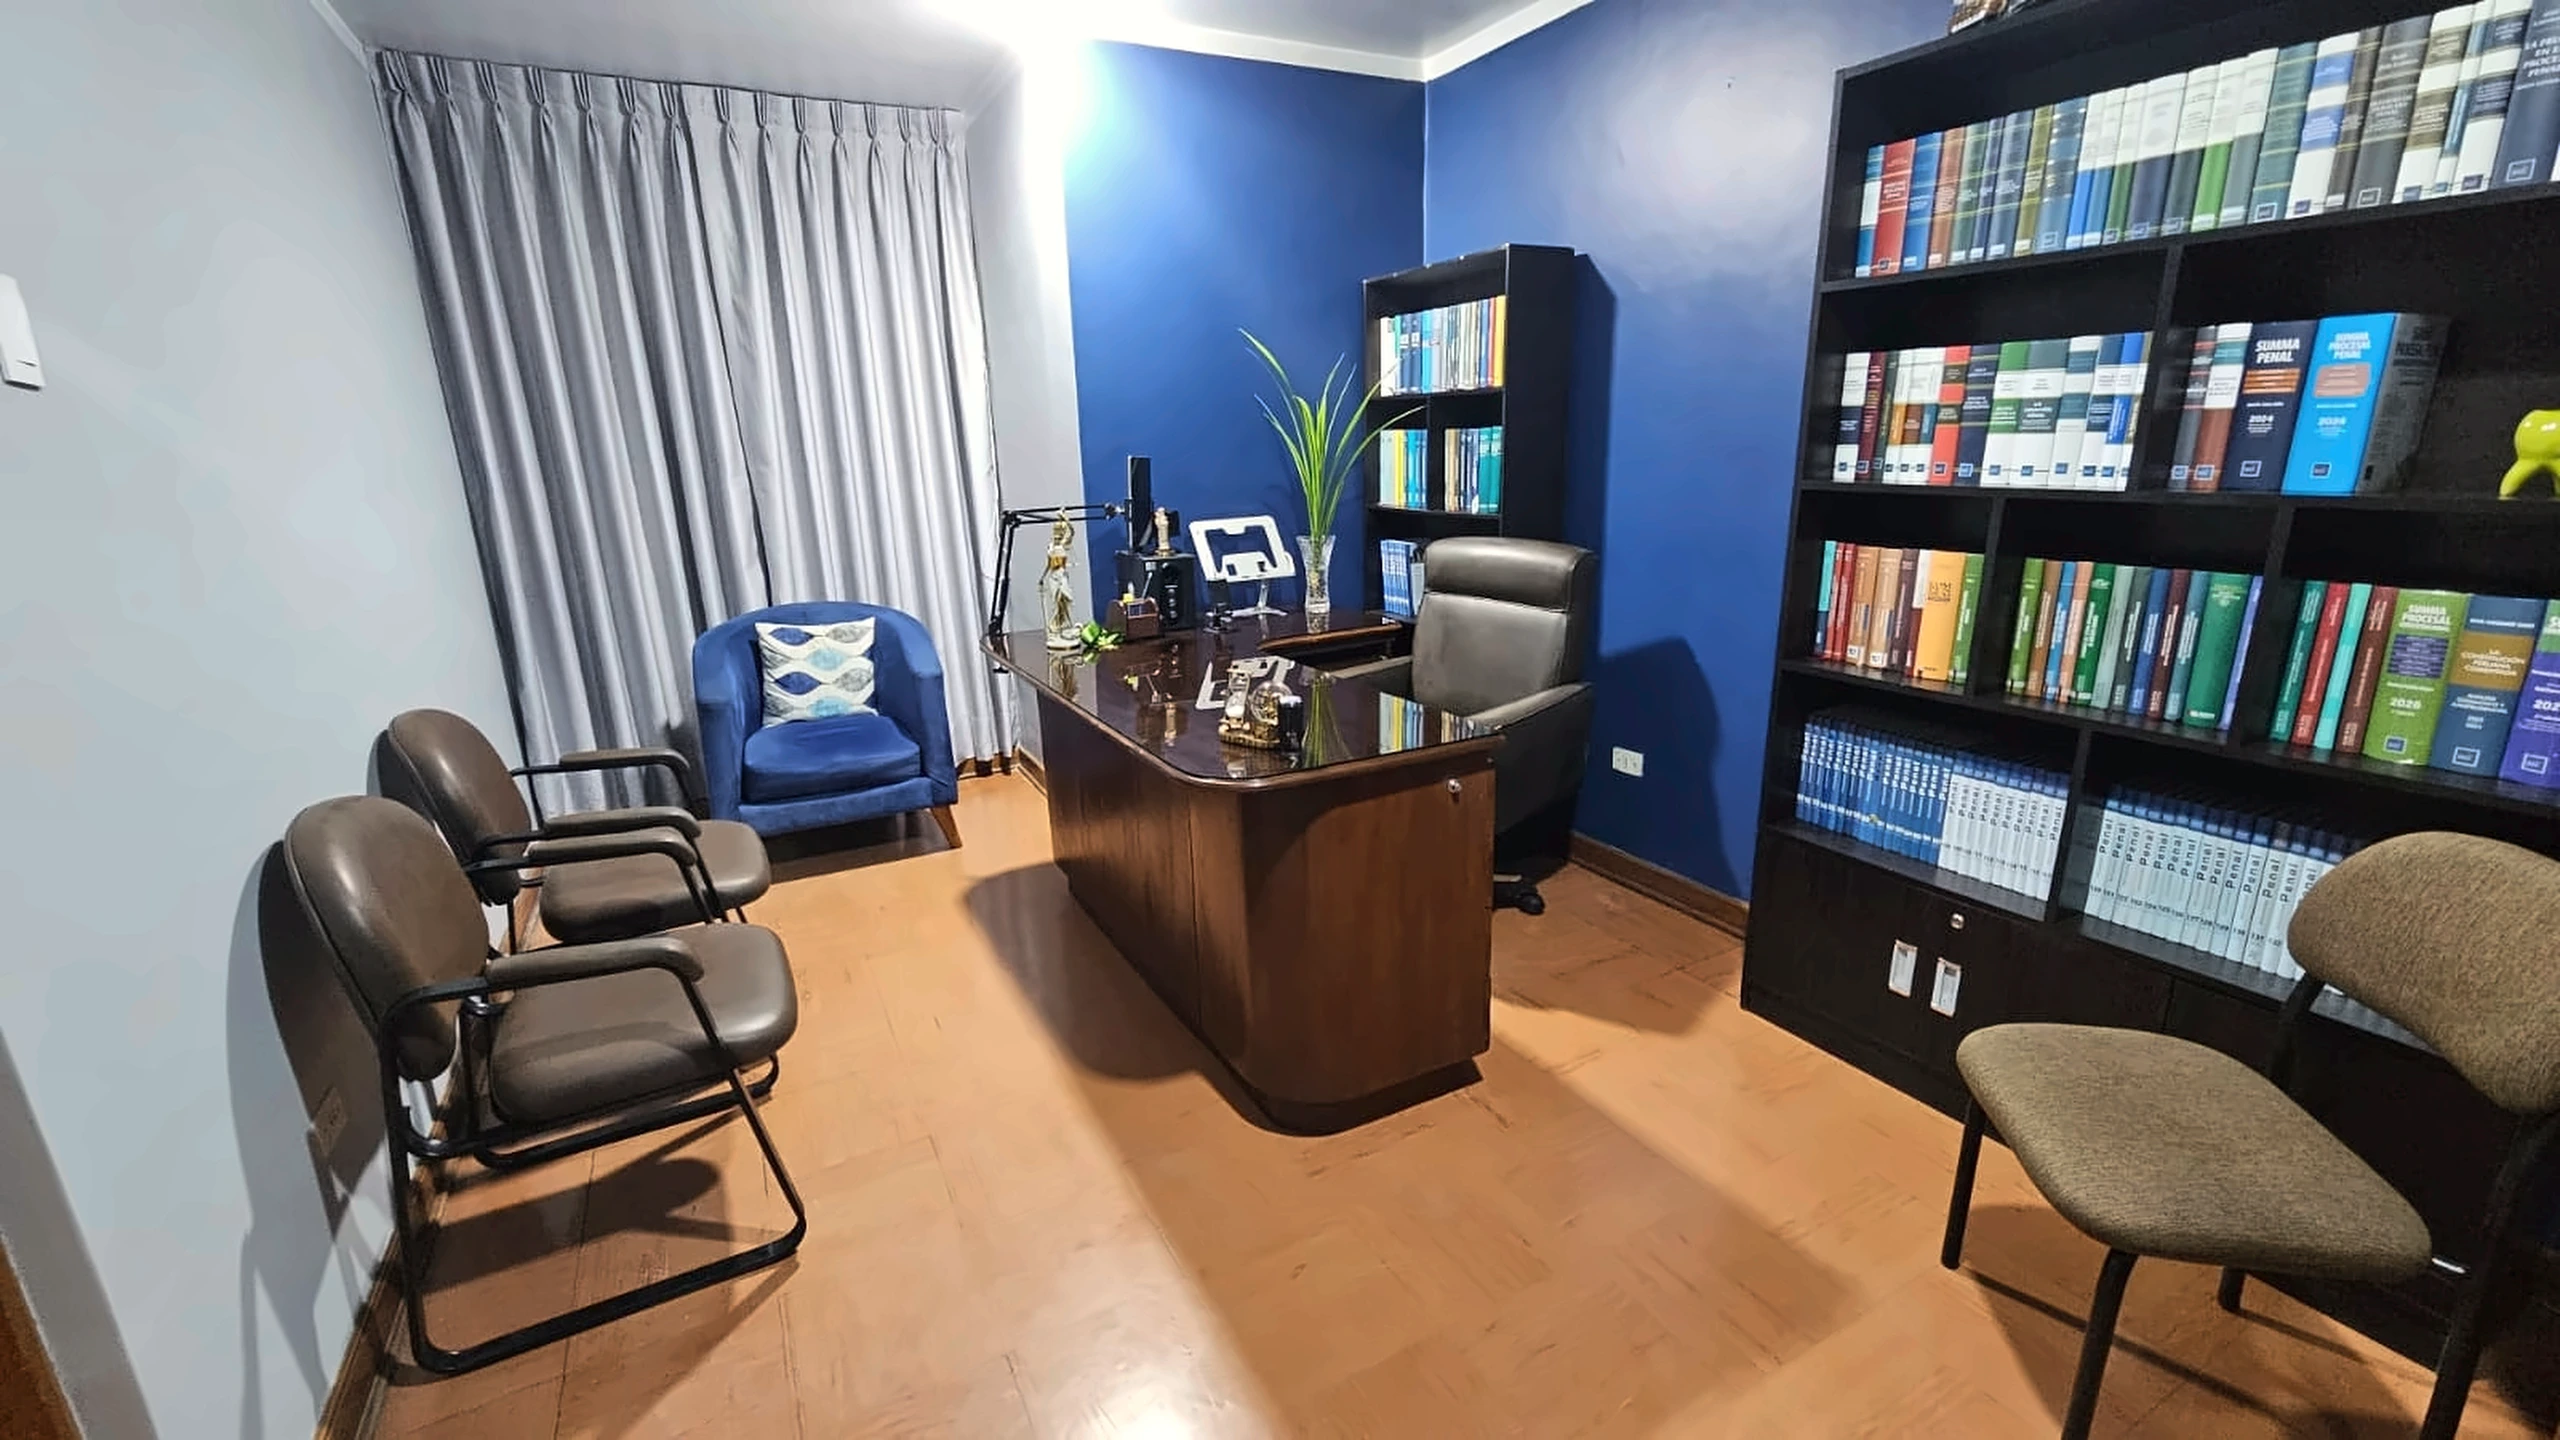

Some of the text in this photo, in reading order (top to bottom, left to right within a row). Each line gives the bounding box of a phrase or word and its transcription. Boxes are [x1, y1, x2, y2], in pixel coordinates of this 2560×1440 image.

[2255, 338, 2300, 352] SUMMA
[2256, 351, 2294, 365] PENAL
[2328, 339, 2372, 351] PROCESAL
[2334, 350, 2361, 359] PENAL
[2402, 612, 2451, 625] PROCESAL
[2408, 604, 2446, 616] SUMMA
[2533, 699, 2560, 713] 202
[1990, 793, 2003, 827] Penal
[2001, 795, 2014, 829] Penal
[2014, 799, 2026, 833] Penal
[2025, 800, 2039, 834] Penal
[2037, 804, 2049, 838] Penal
[2049, 806, 2063, 841] Penal
[2099, 818, 2113, 854] Penal
[2112, 822, 2127, 859] Penal
[2126, 826, 2140, 862] Penal
[2139, 829, 2155, 866] Penal
[2153, 832, 2169, 870] Penal
[2167, 834, 2183, 872] Penal
[2180, 838, 2197, 877] Penal
[2196, 843, 2213, 881] Penal
[2209, 847, 2226, 885] Penal
[2225, 850, 2243, 889] Penal
[2243, 854, 2261, 894] Penal
[2262, 859, 2280, 899] Penal
[2281, 863, 2298, 903] Penal
[2302, 867, 2317, 897] nal
